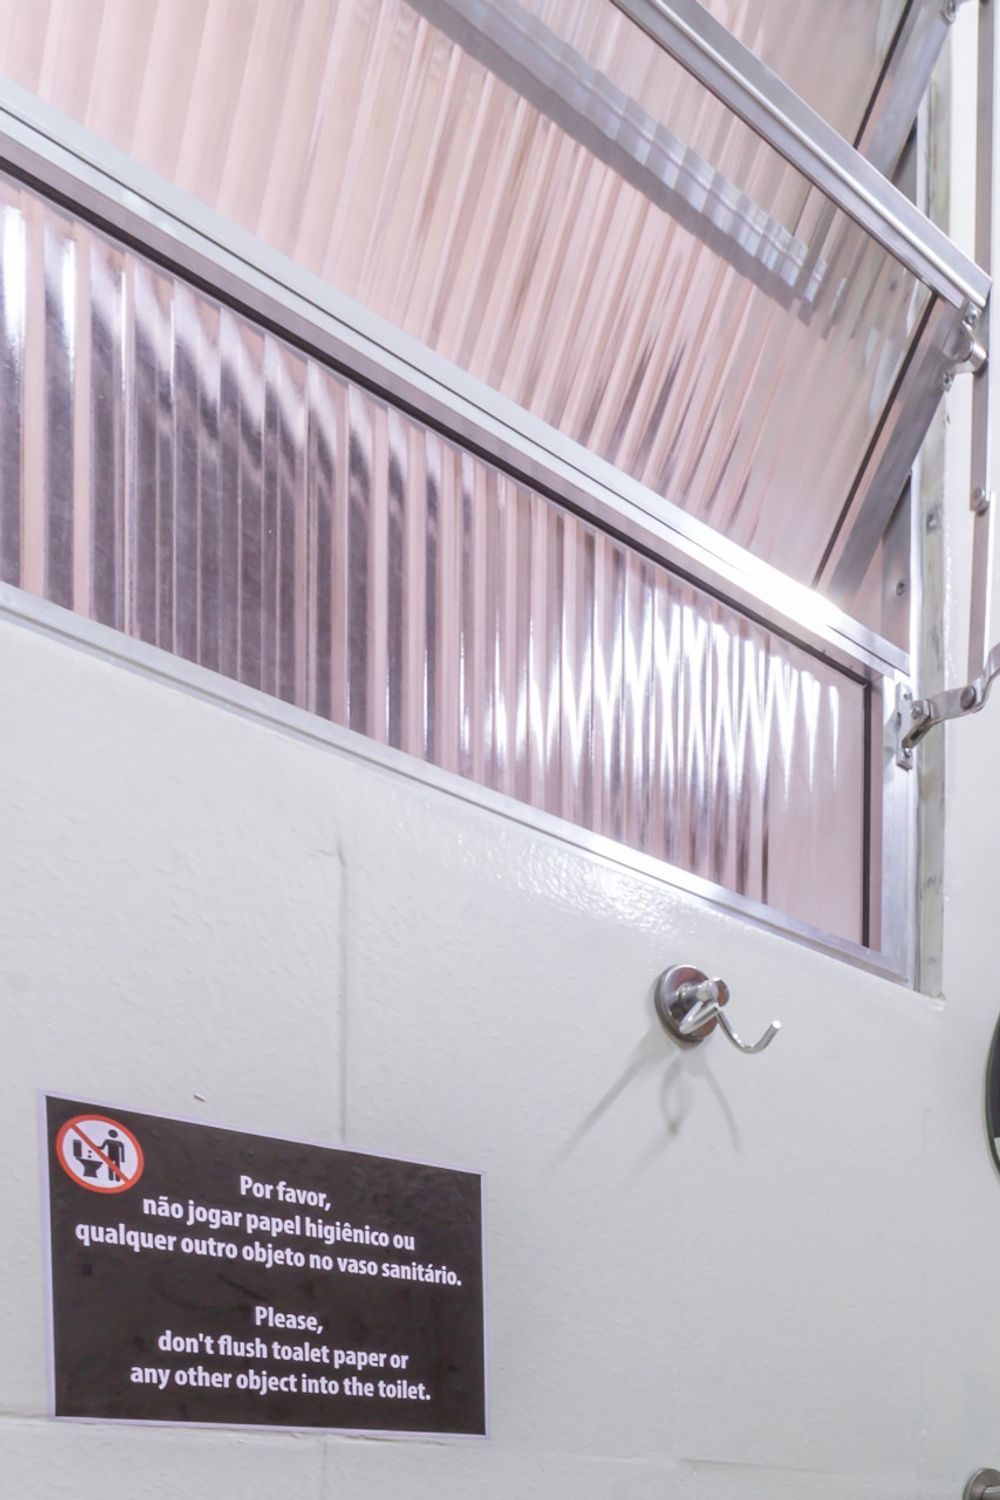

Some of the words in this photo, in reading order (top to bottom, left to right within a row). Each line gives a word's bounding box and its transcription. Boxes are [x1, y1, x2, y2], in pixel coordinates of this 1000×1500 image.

[239, 1175, 273, 1199] Por
[277, 1181, 331, 1211] favor,
[143, 1196, 184, 1219] não
[186, 1200, 243, 1229] jogar
[246, 1213, 300, 1237] papel
[305, 1216, 389, 1247] higiênico
[393, 1235, 415, 1250] ou
[75, 1223, 177, 1252] qualquer
[181, 1236, 238, 1259] outro
[242, 1241, 305, 1268] objeto
[309, 1253, 333, 1271] no
[337, 1256, 378, 1276] vaso
[382, 1261, 462, 1286] sanitário.
[255, 1306, 323, 1334] Please,
[158, 1329, 214, 1355] don't
[218, 1334, 267, 1358] flush
[272, 1341, 330, 1364] toalet
[333, 1349, 387, 1371] paper
[390, 1353, 409, 1369] or
[130, 1366, 170, 1390] any
[174, 1366, 232, 1389] other
[236, 1369, 297, 1396] object
[302, 1373, 339, 1395] into
[343, 1376, 374, 1398] the
[378, 1379, 431, 1401] toilet.
